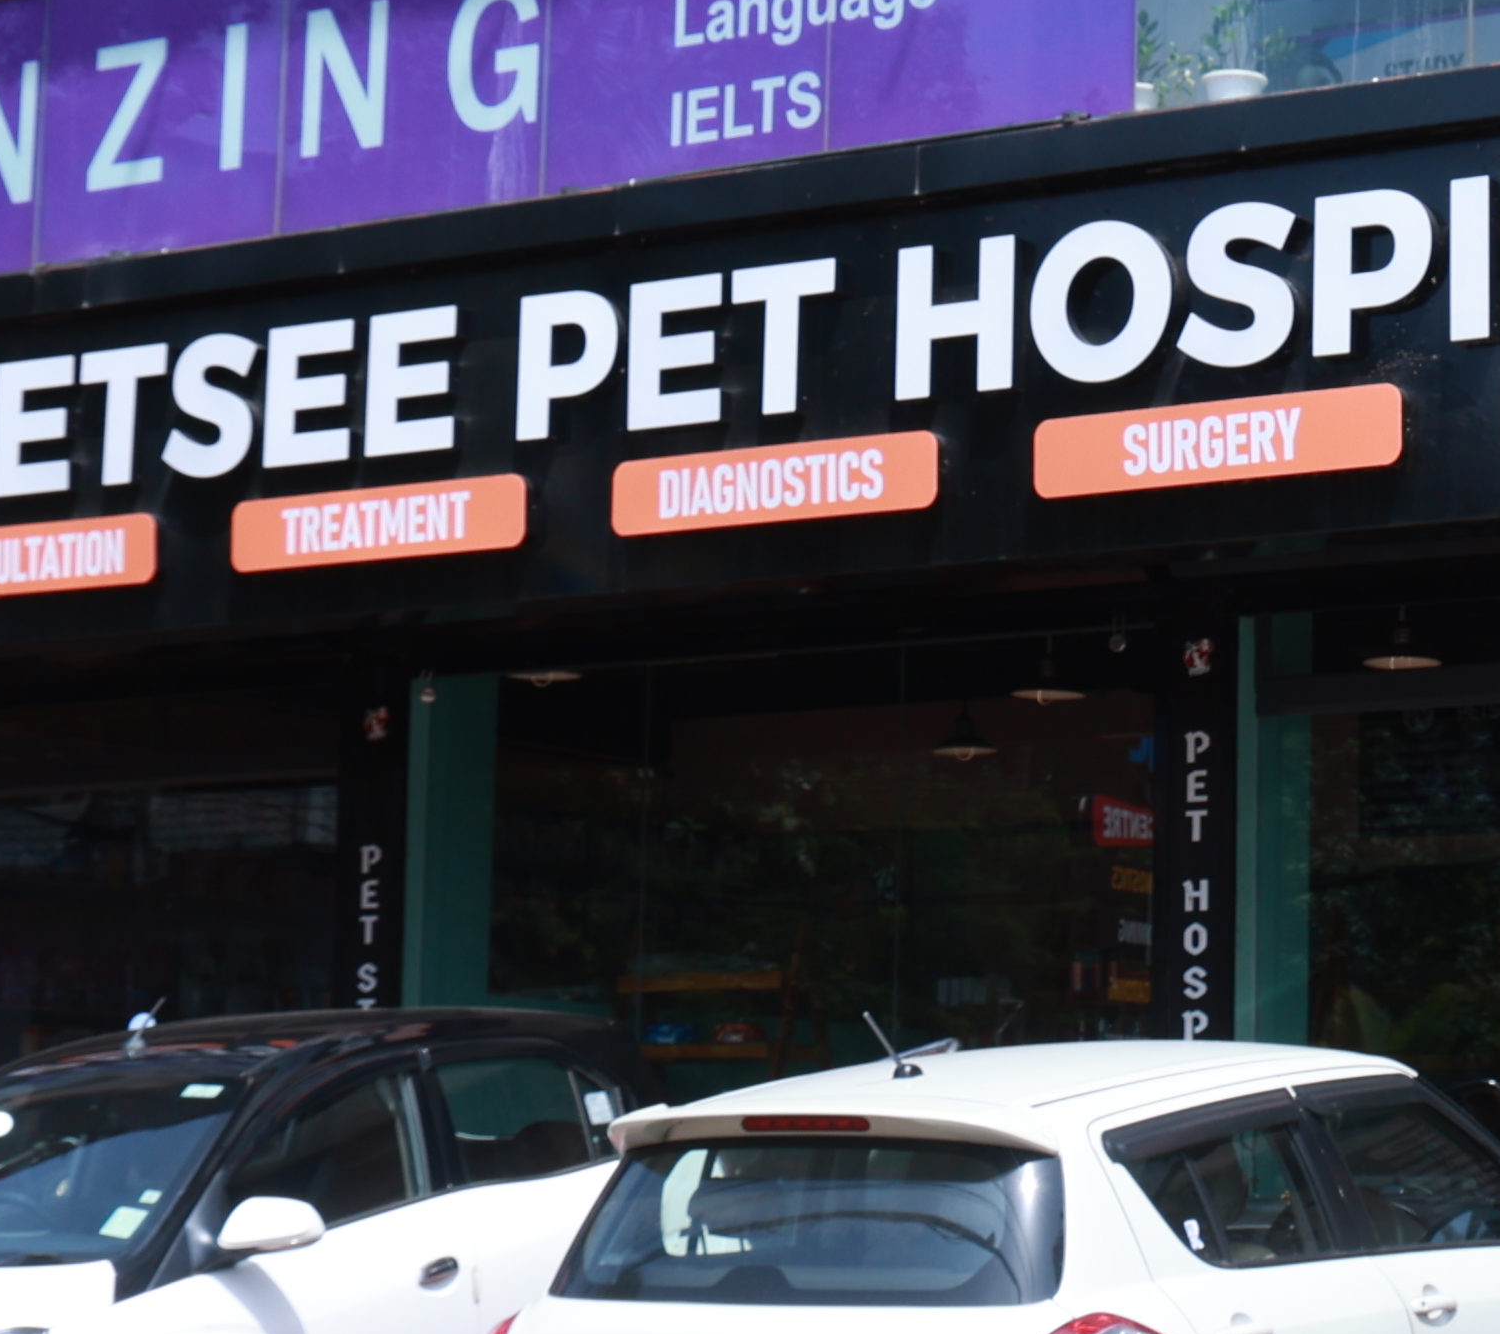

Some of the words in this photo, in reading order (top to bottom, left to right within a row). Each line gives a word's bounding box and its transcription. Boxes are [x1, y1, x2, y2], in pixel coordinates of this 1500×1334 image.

[670, 69, 824, 148] IELTS
[516, 257, 837, 442] PET
[1121, 406, 1301, 476] SURGERY
[281, 490, 471, 556] TREATMENT
[658, 448, 884, 520] DIAGNOSTICS
[1183, 729, 1212, 843] PET
[358, 842, 383, 945] PET
